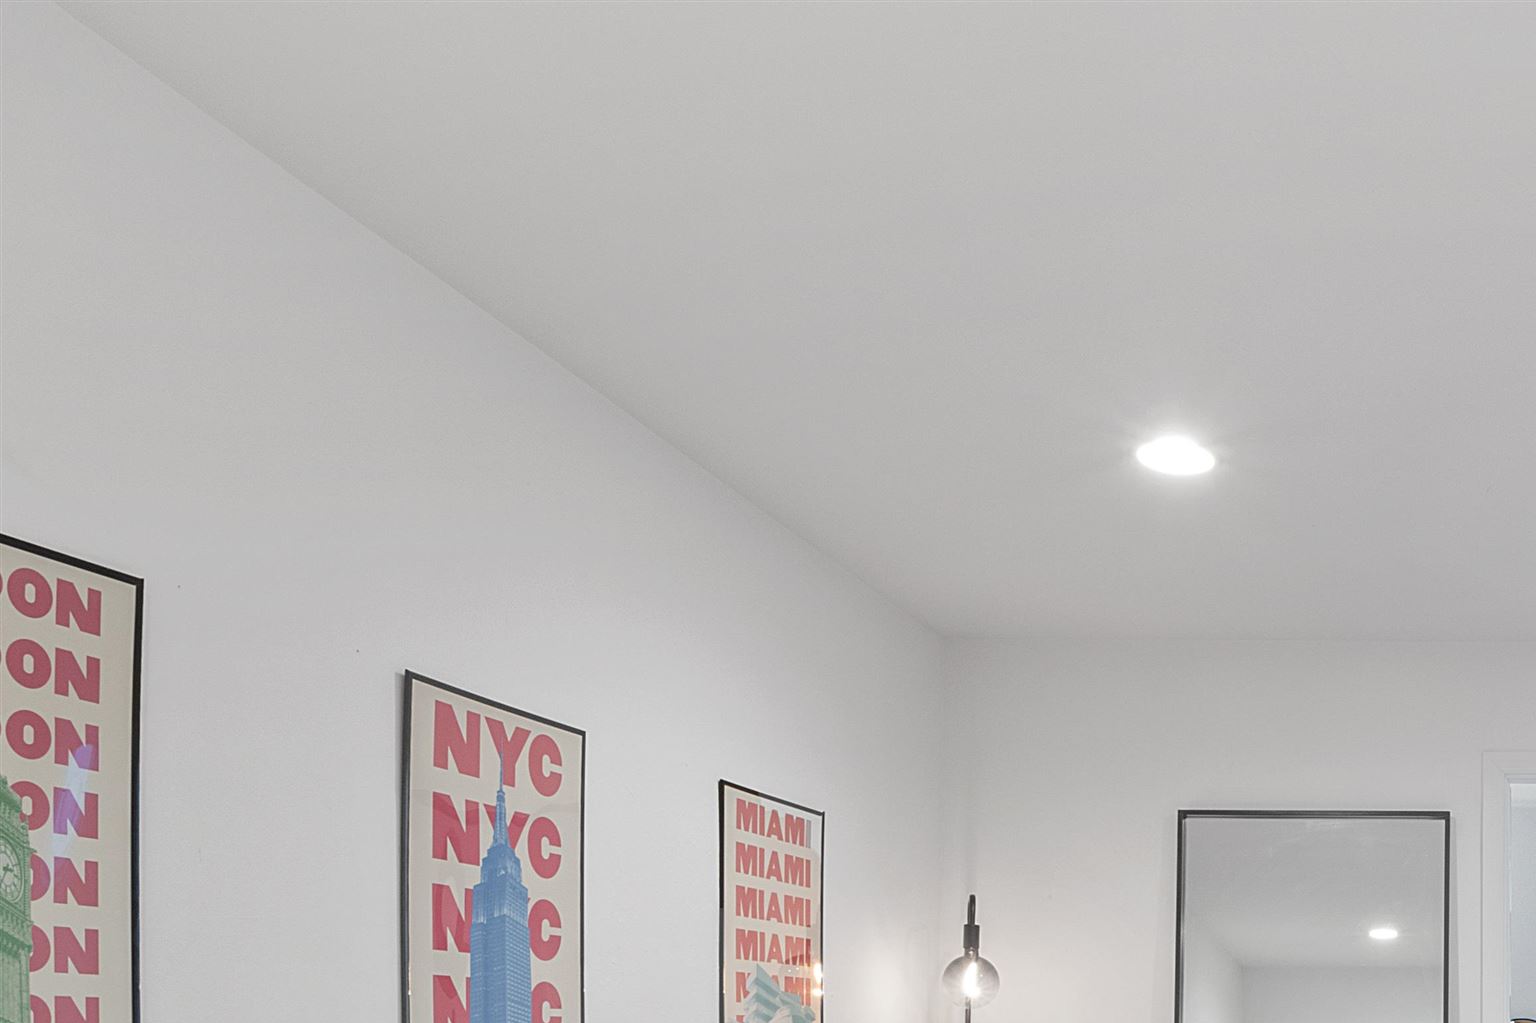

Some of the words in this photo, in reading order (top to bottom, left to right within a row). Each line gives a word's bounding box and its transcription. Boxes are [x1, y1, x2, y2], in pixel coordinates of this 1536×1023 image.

[0, 568, 102, 637] ON
[0, 639, 101, 704] ON
[0, 710, 100, 771] ON
[433, 699, 562, 797] NYC
[736, 797, 811, 849] MIAMI
[736, 841, 811, 888] MIAMI
[432, 883, 562, 962] NC
[736, 885, 811, 928] MIAMI
[736, 928, 811, 967] MIAMI
[736, 971, 811, 1007] MMI
